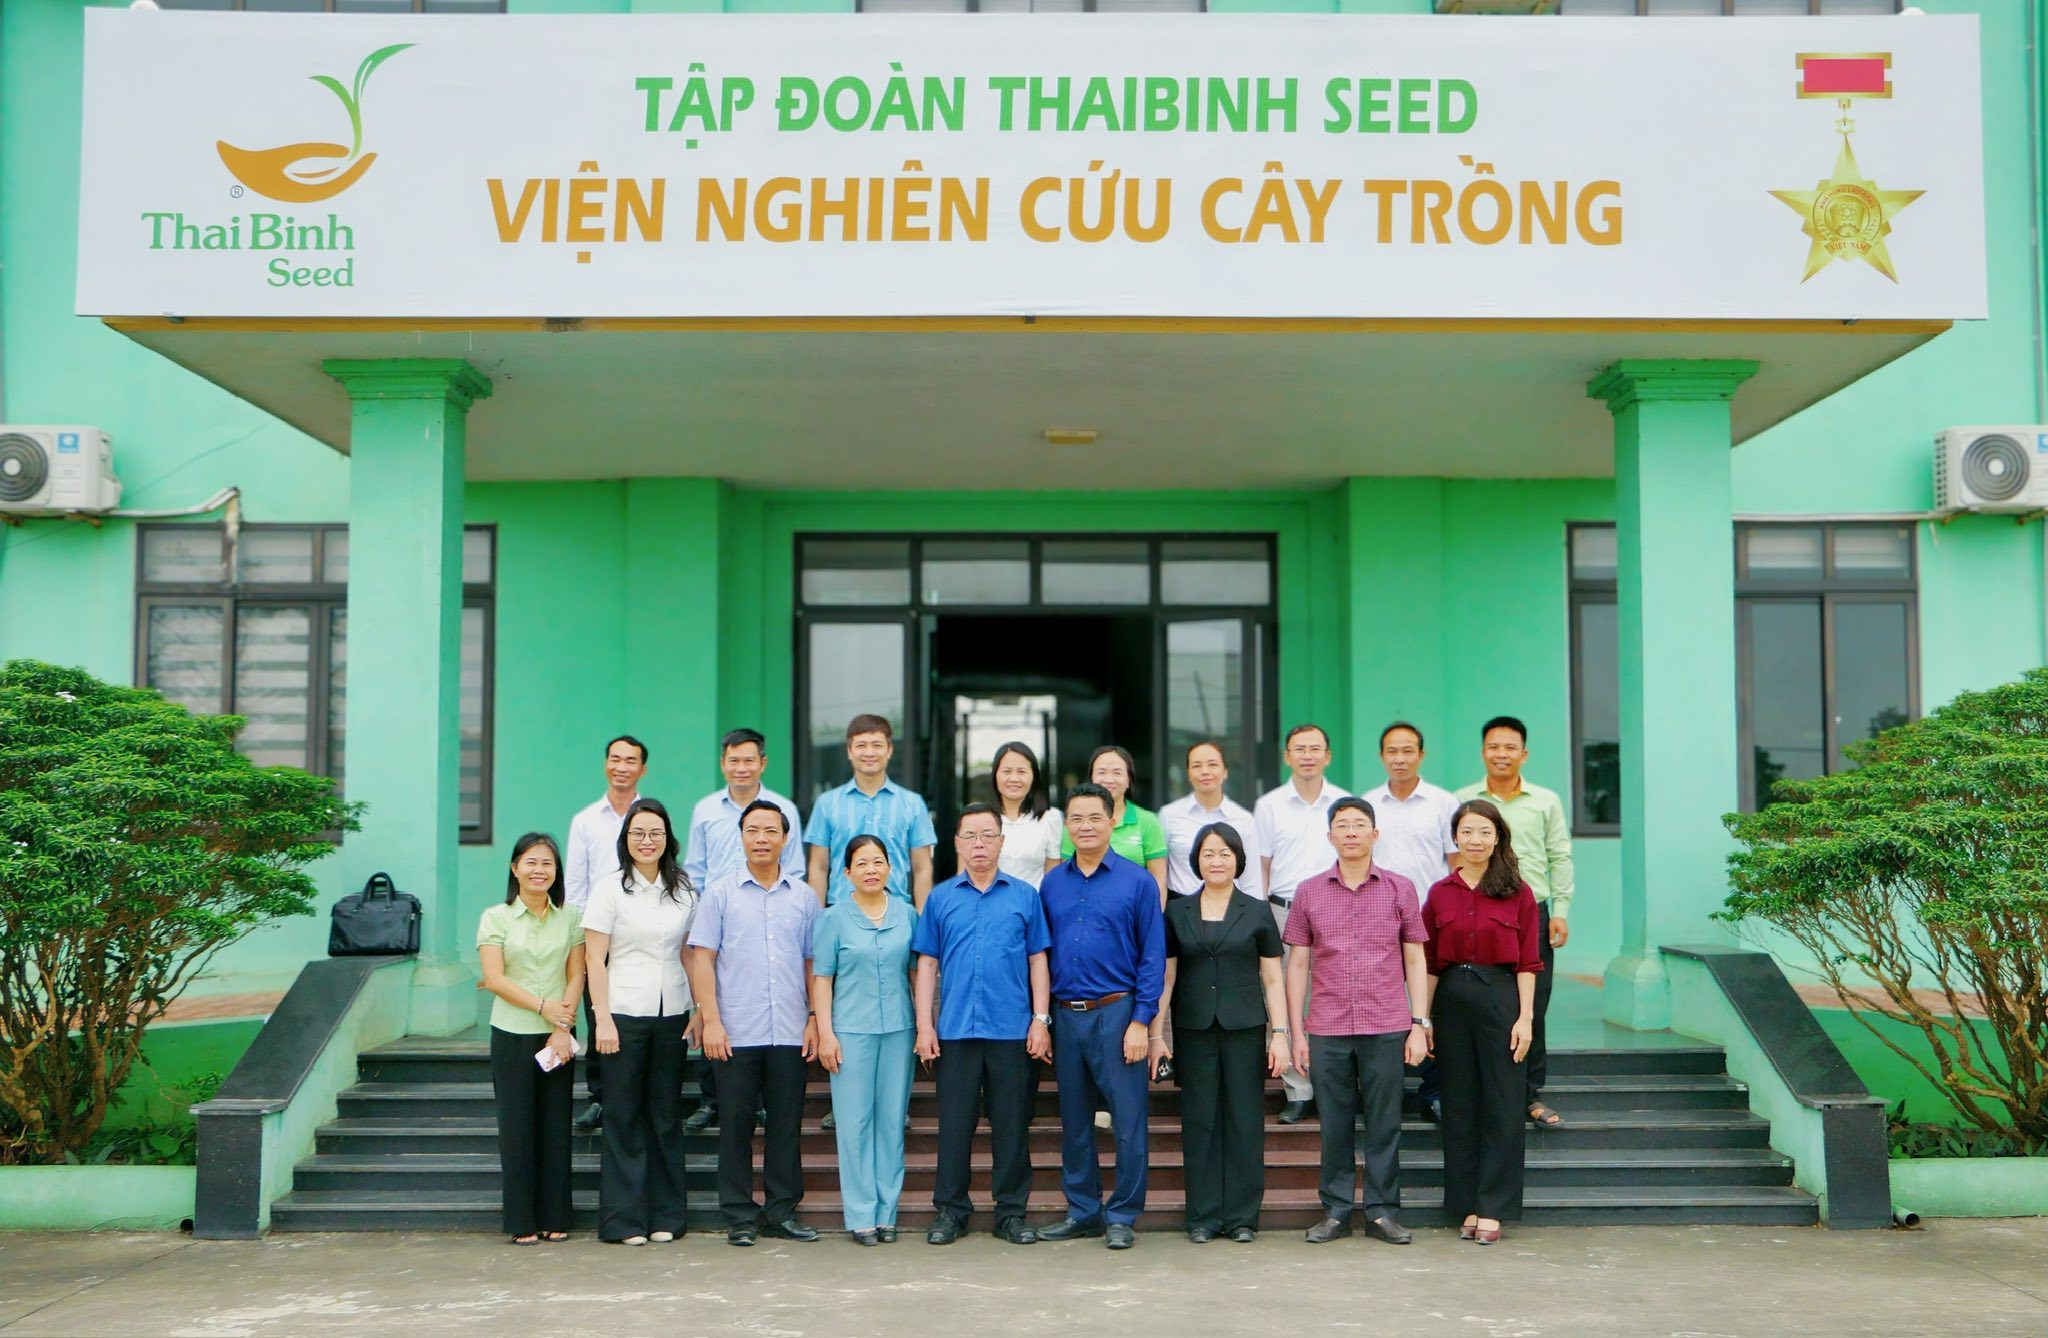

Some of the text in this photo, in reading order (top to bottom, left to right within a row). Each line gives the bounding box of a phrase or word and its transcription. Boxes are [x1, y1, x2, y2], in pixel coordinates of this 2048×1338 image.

[635, 62, 1478, 149] TẬP ĐOÀN THAIBINH SEED
[486, 154, 1623, 264] VIỆN NGHIÊN CỨU CÂY TRỒNG
[267, 258, 354, 287] Seed
